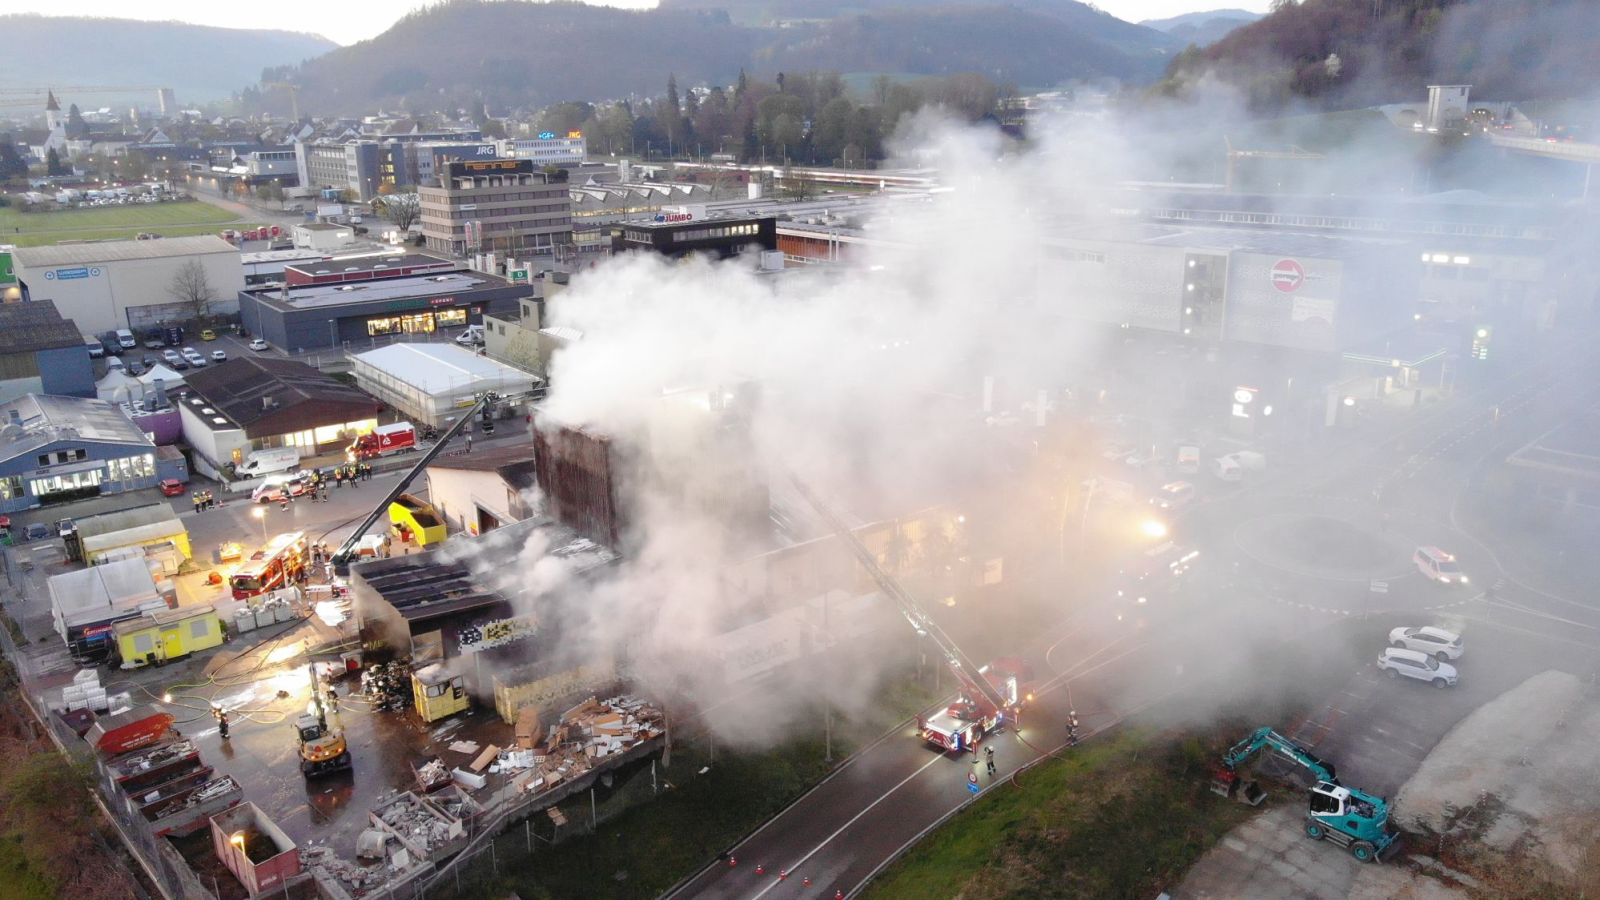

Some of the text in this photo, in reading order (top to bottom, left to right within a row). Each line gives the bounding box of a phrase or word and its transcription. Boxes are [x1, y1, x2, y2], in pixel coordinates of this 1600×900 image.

[568, 131, 581, 139] JRG
[476, 146, 494, 155] JRG
[665, 213, 692, 223] JUMBO
